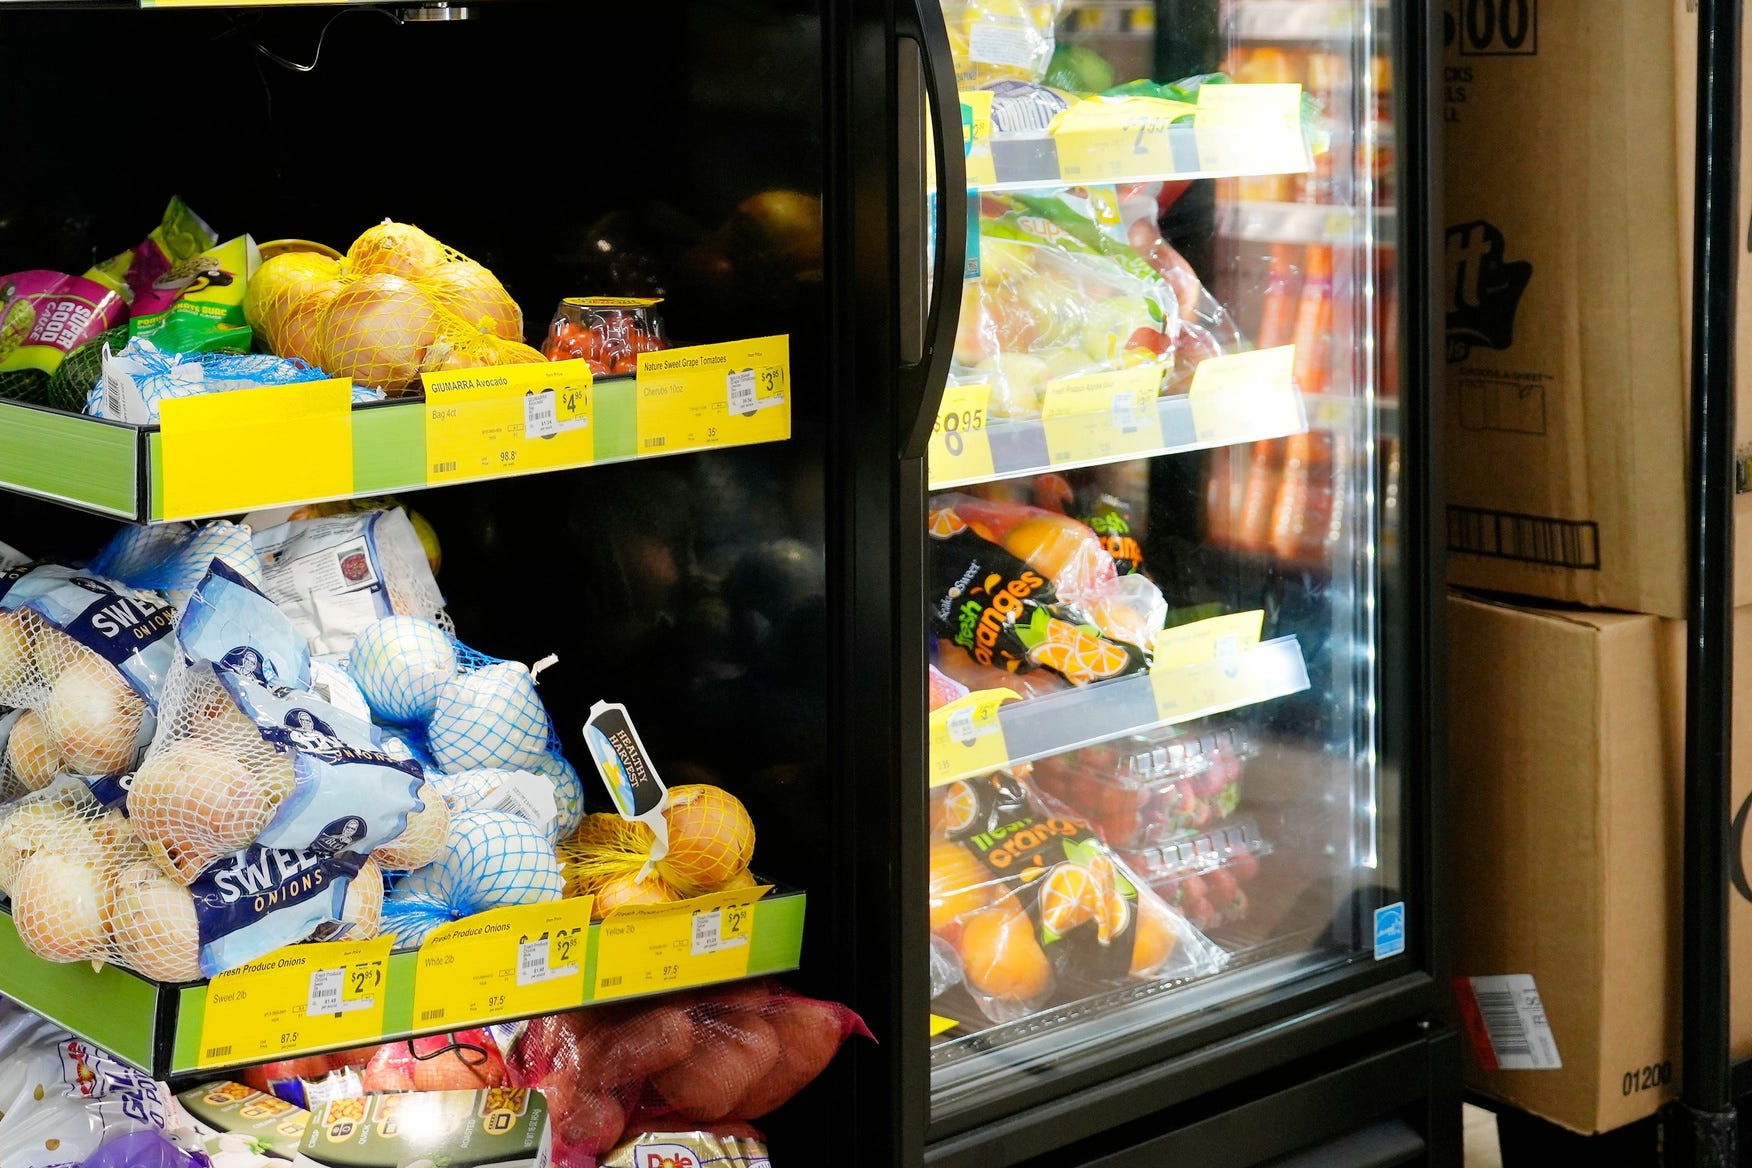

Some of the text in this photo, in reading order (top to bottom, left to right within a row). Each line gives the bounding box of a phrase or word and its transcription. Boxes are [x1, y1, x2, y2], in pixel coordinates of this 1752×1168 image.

[30, 302, 53, 342] CAUSE
[41, 301, 74, 343] GOOD
[201, 306, 227, 317] GUAC
[58, 304, 92, 350] SUPER
[644, 355, 727, 372] Nature Sweet Grape Tomatoes
[431, 377, 508, 393] GIUMARRA Avocado
[643, 384, 684, 397] Cherubs 10oz
[432, 407, 456, 421] Bag 4ct
[955, 598, 983, 648] fresh
[974, 570, 1044, 667] oranges
[609, 734, 640, 789] HARVEST
[616, 729, 648, 783] HEALTHY
[254, 868, 323, 913] ONIONS
[431, 922, 511, 945] Fresh Produce Onions
[605, 926, 626, 937] Yellow
[218, 956, 306, 979] Fresh Produce Onions
[425, 955, 455, 968] White 2lb
[212, 989, 247, 1005] Sweet 2lb
[1621, 1060, 1672, 1097] 01200
[308, 1129, 320, 1148] CRISP
[358, 1124, 371, 1145] QUICK
[460, 1119, 477, 1149] ROASTED
[647, 1152, 693, 1168] Dole
